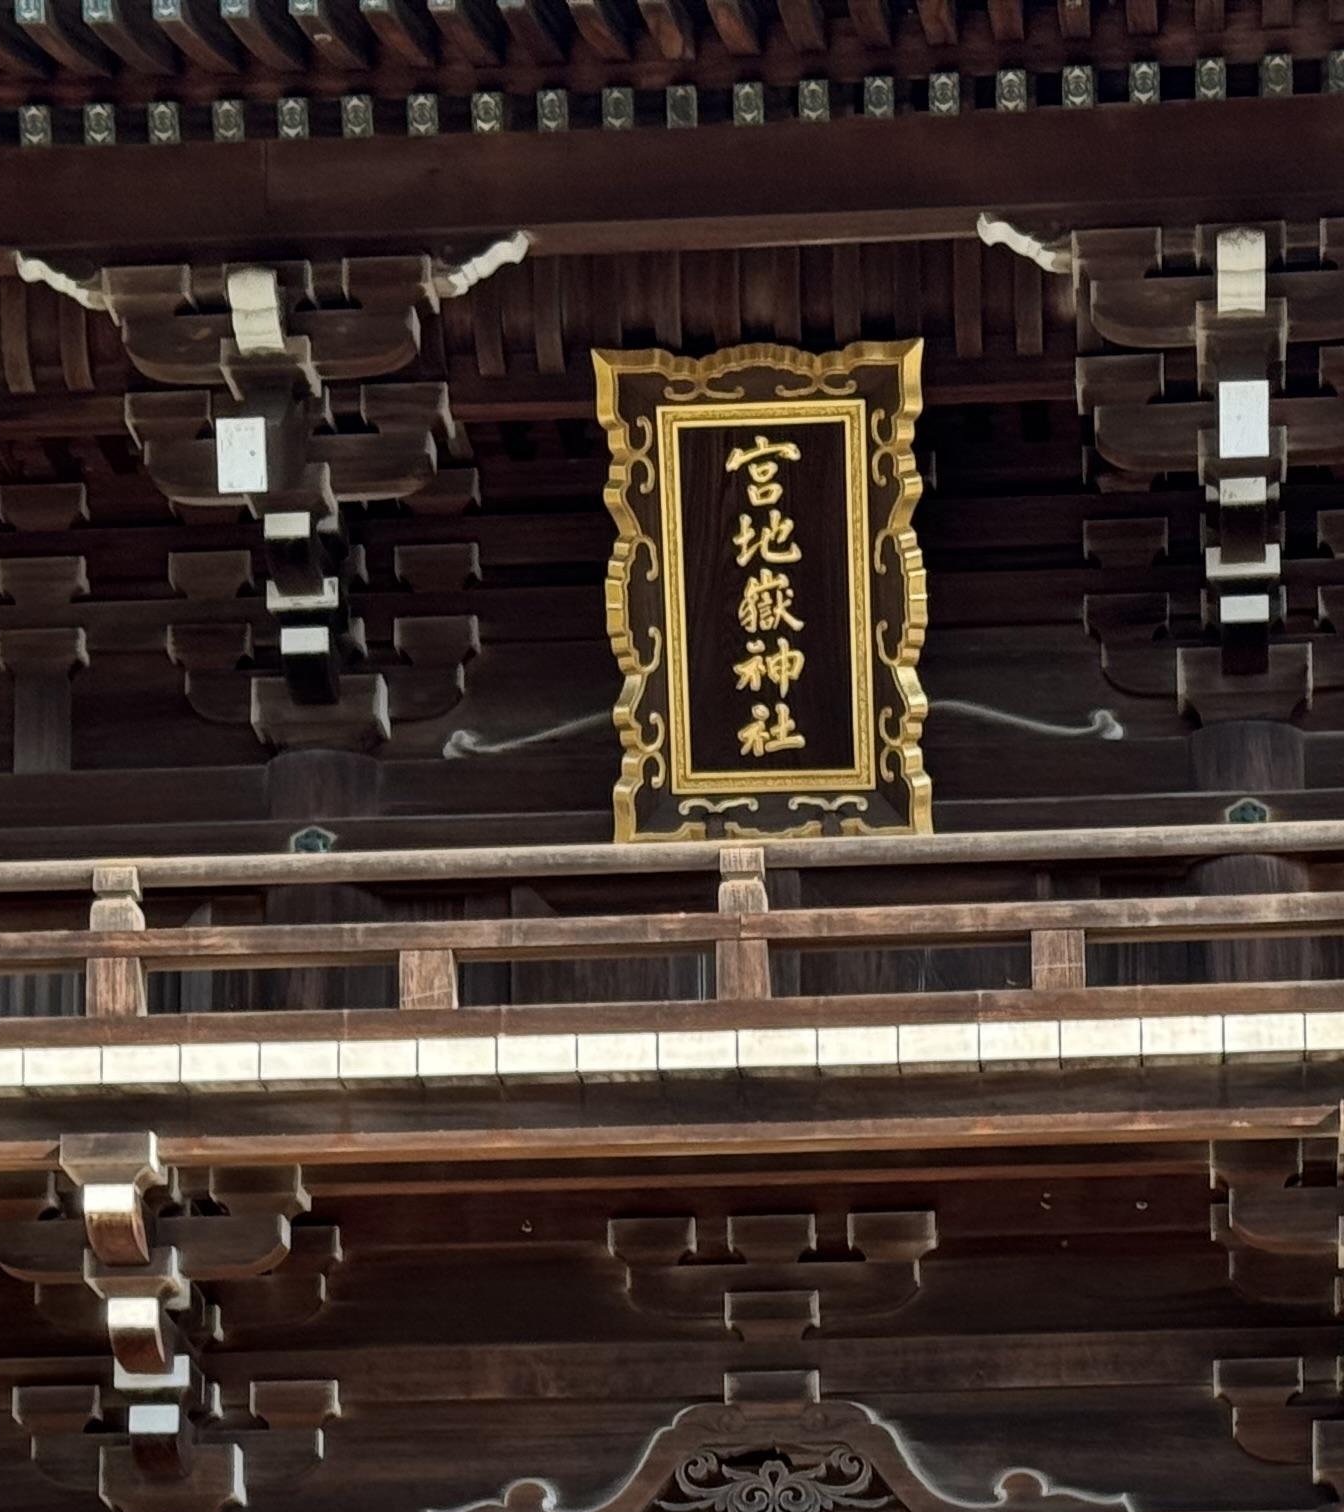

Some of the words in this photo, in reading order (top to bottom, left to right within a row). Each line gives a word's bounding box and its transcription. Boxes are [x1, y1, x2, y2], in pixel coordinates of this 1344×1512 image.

[726, 436, 805, 757] 宮地嶽神社
